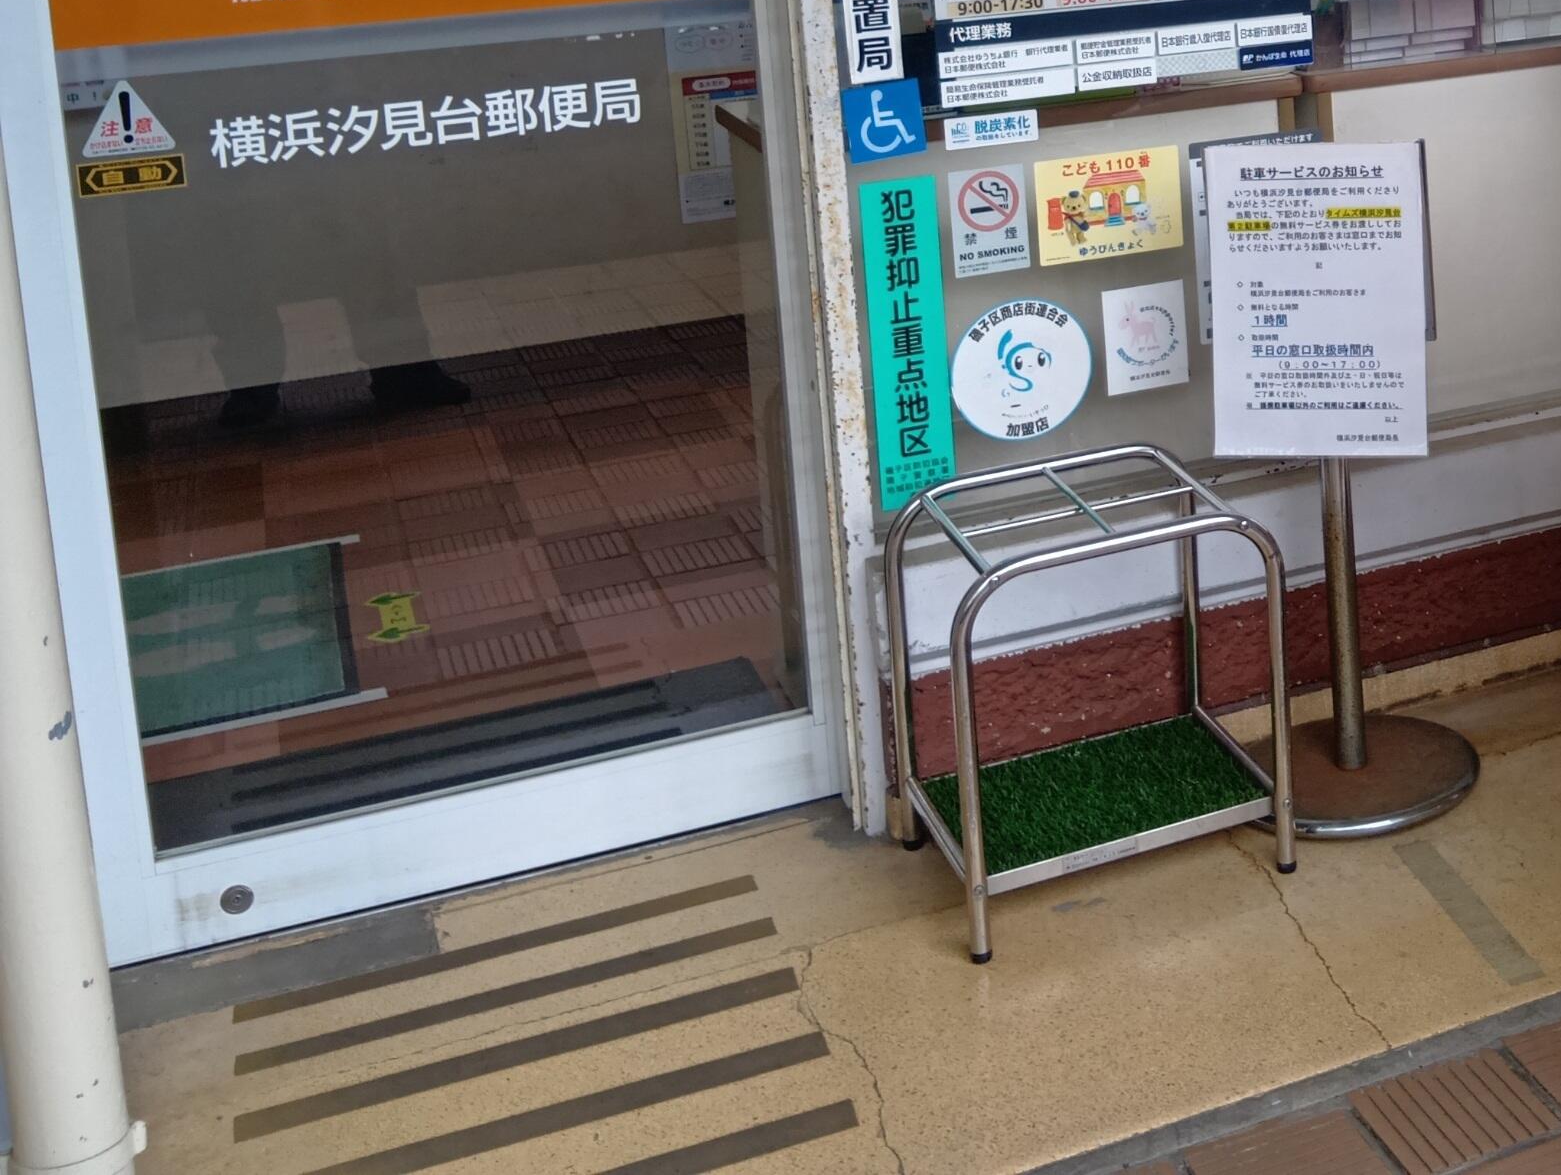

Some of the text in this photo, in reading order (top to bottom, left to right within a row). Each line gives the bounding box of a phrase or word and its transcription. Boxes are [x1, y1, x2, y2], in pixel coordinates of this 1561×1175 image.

[949, 21, 1013, 44] 代理業務
[1081, 46, 1140, 60] 日本郵便株式会社
[944, 60, 1006, 74] 日本郵便株式会社
[1082, 64, 1152, 84] 公金収納取扱店
[947, 88, 1009, 104] 日本郵便株式会社
[209, 78, 643, 170] 横浜汐見台郵便局
[974, 115, 1031, 135] 脱炭素化
[1240, 165, 1385, 180] 駐車サービスのお知らせ
[1227, 200, 1315, 209] ありがとうございます。
[964, 227, 1018, 246] 禁煙
[959, 244, 1025, 262] NO SMOKING
[1079, 239, 1145, 257] ゆうびんきょく
[880, 188, 933, 459] 犯罪抑止重点地区
[968, 302, 1069, 343] 磯子区商店街連合会
[1252, 343, 1375, 357] 平日の窓口取扱時間内
[1005, 416, 1050, 437] 加盟店
